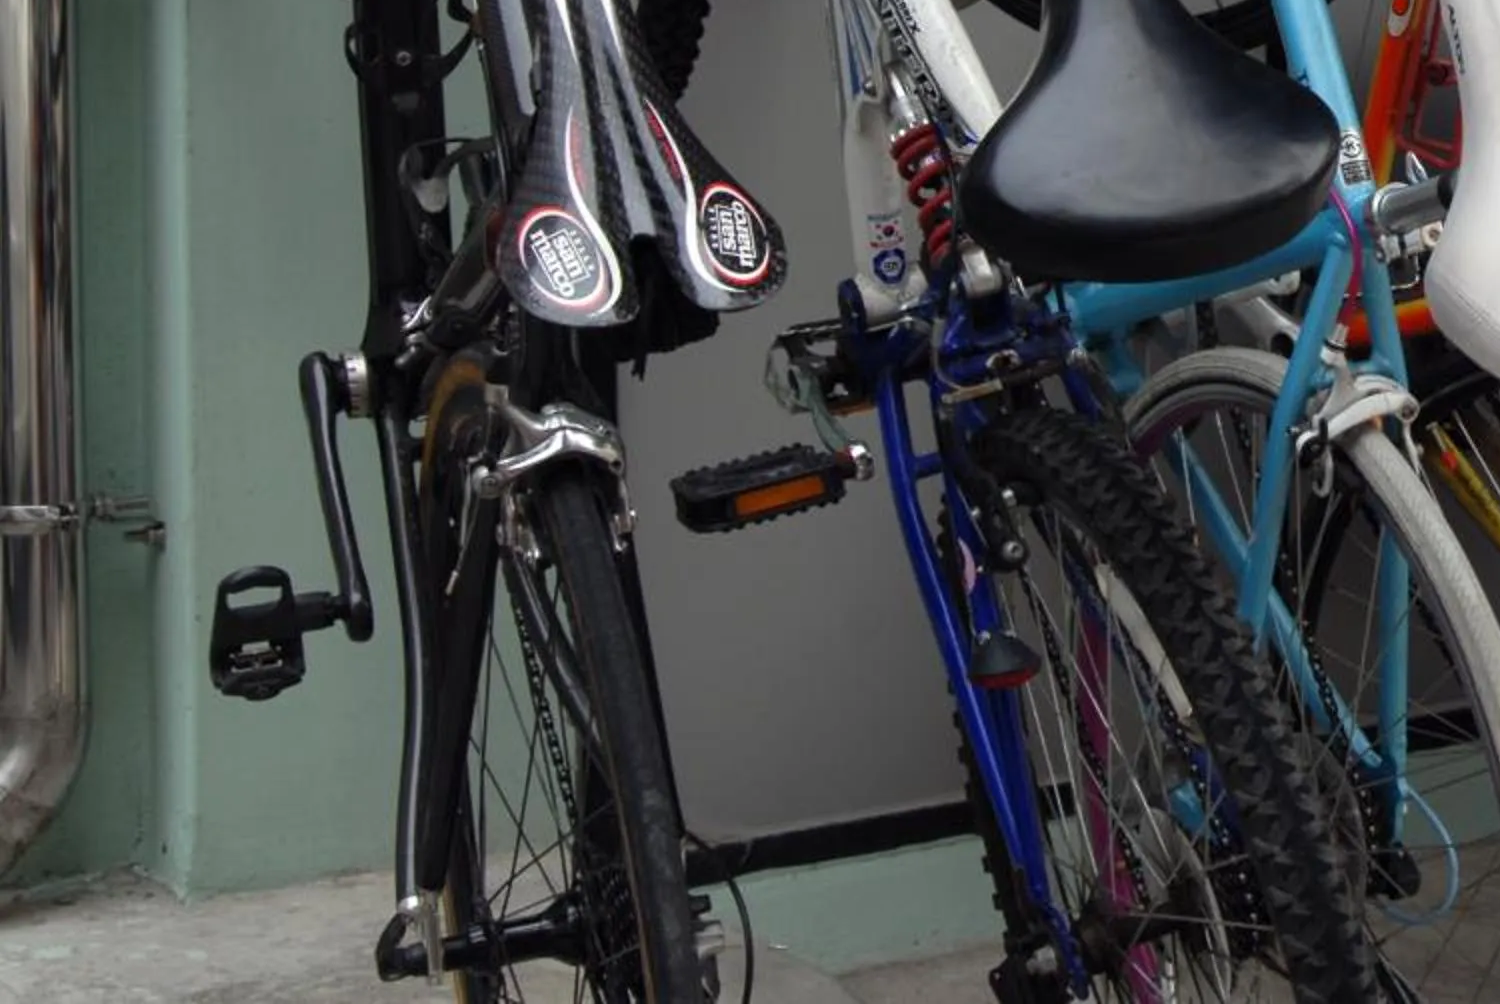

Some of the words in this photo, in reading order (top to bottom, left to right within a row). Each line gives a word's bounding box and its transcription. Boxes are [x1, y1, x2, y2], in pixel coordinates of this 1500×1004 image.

[552, 235, 582, 277] san
[719, 209, 737, 251] san
[731, 200, 755, 268] marco
[531, 229, 575, 297] marco
